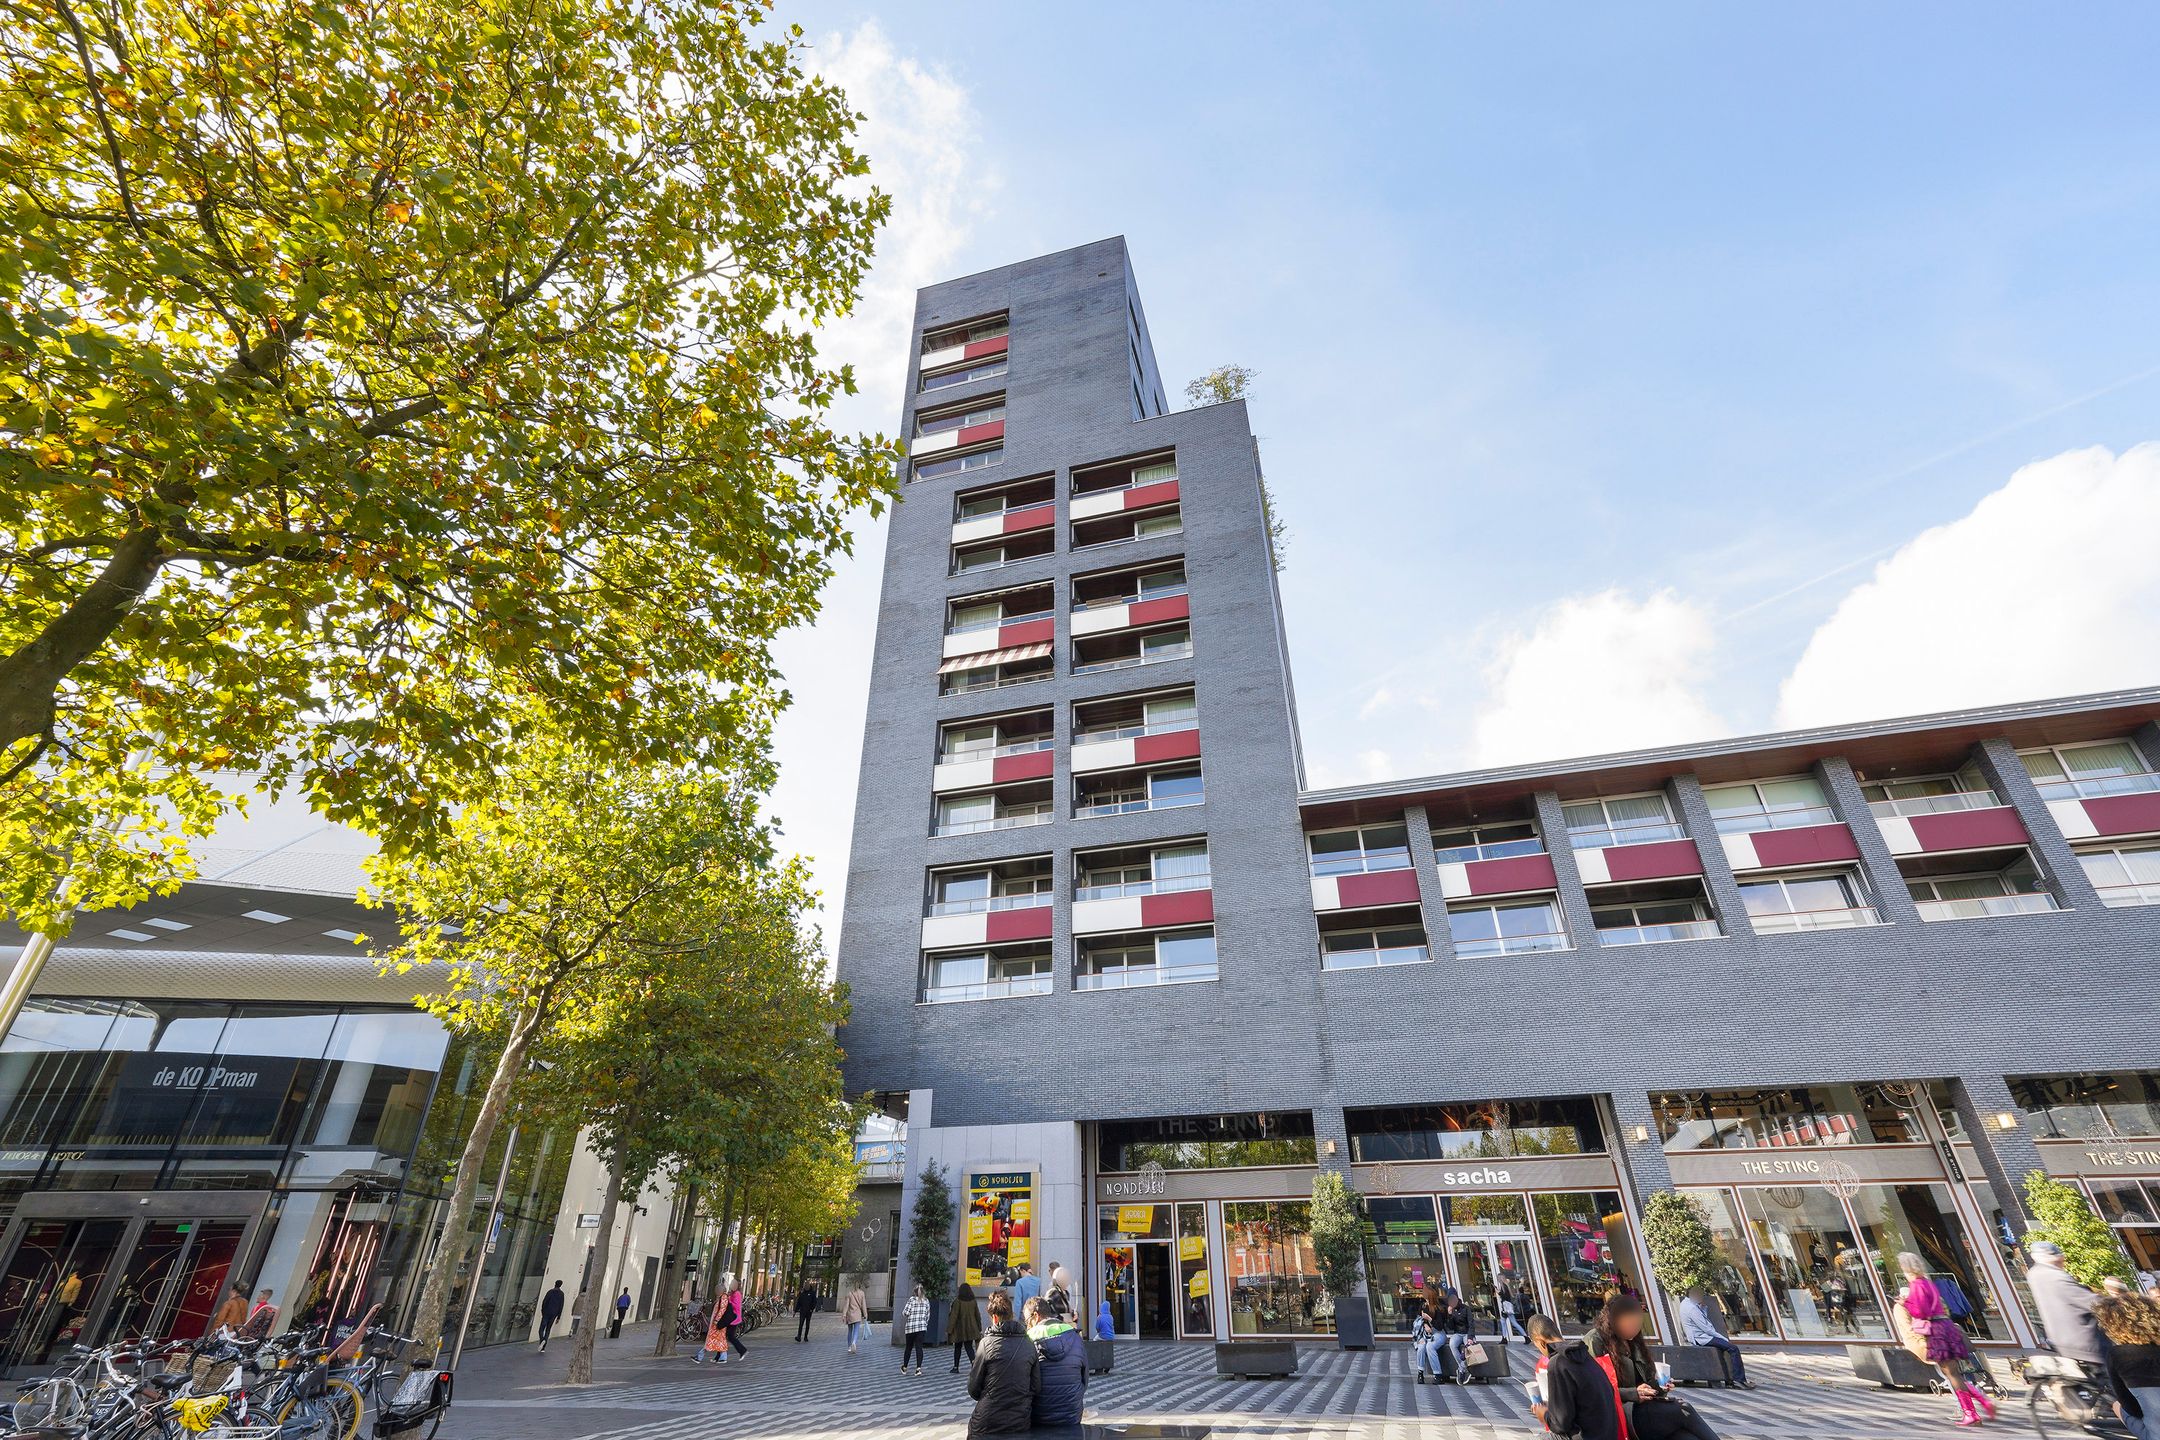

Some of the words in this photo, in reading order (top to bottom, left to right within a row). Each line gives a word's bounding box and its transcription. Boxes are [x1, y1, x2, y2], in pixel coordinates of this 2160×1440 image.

[152, 1066, 176, 1086] de
[1156, 1117, 1198, 1135] THE
[1740, 1161, 1772, 1175] THE
[1773, 1160, 1820, 1174] STING
[2085, 1151, 2123, 1166] THE
[1443, 1167, 1512, 1185] sacha
